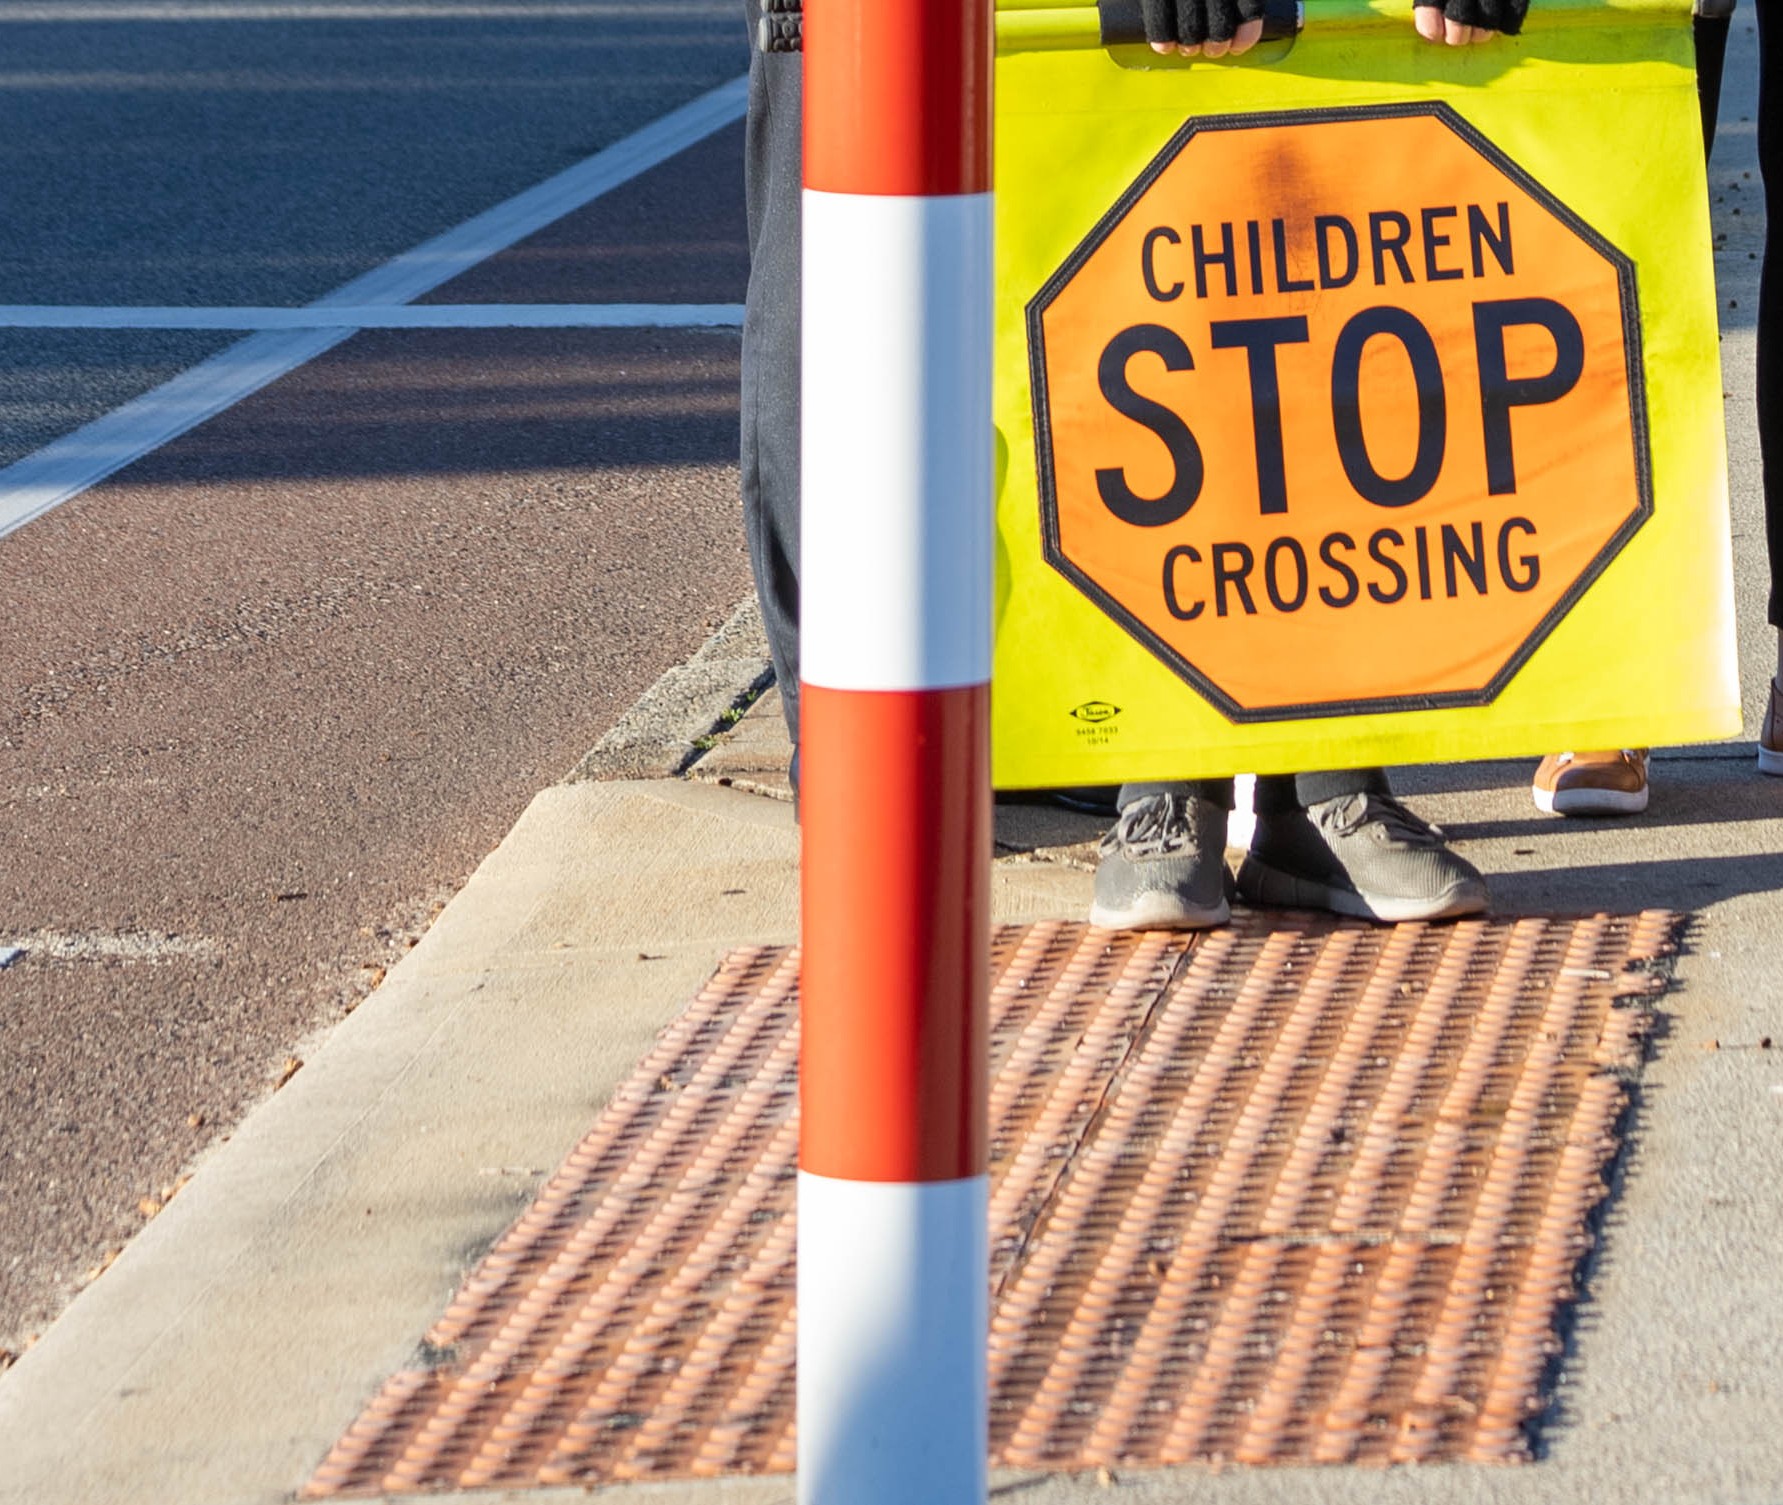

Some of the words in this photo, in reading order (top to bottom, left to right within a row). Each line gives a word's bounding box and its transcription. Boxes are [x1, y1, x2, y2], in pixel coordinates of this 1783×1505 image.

[1141, 201, 1516, 303] CHILDREN
[1094, 297, 1586, 528] STOP
[1161, 516, 1542, 622] CROSSING
